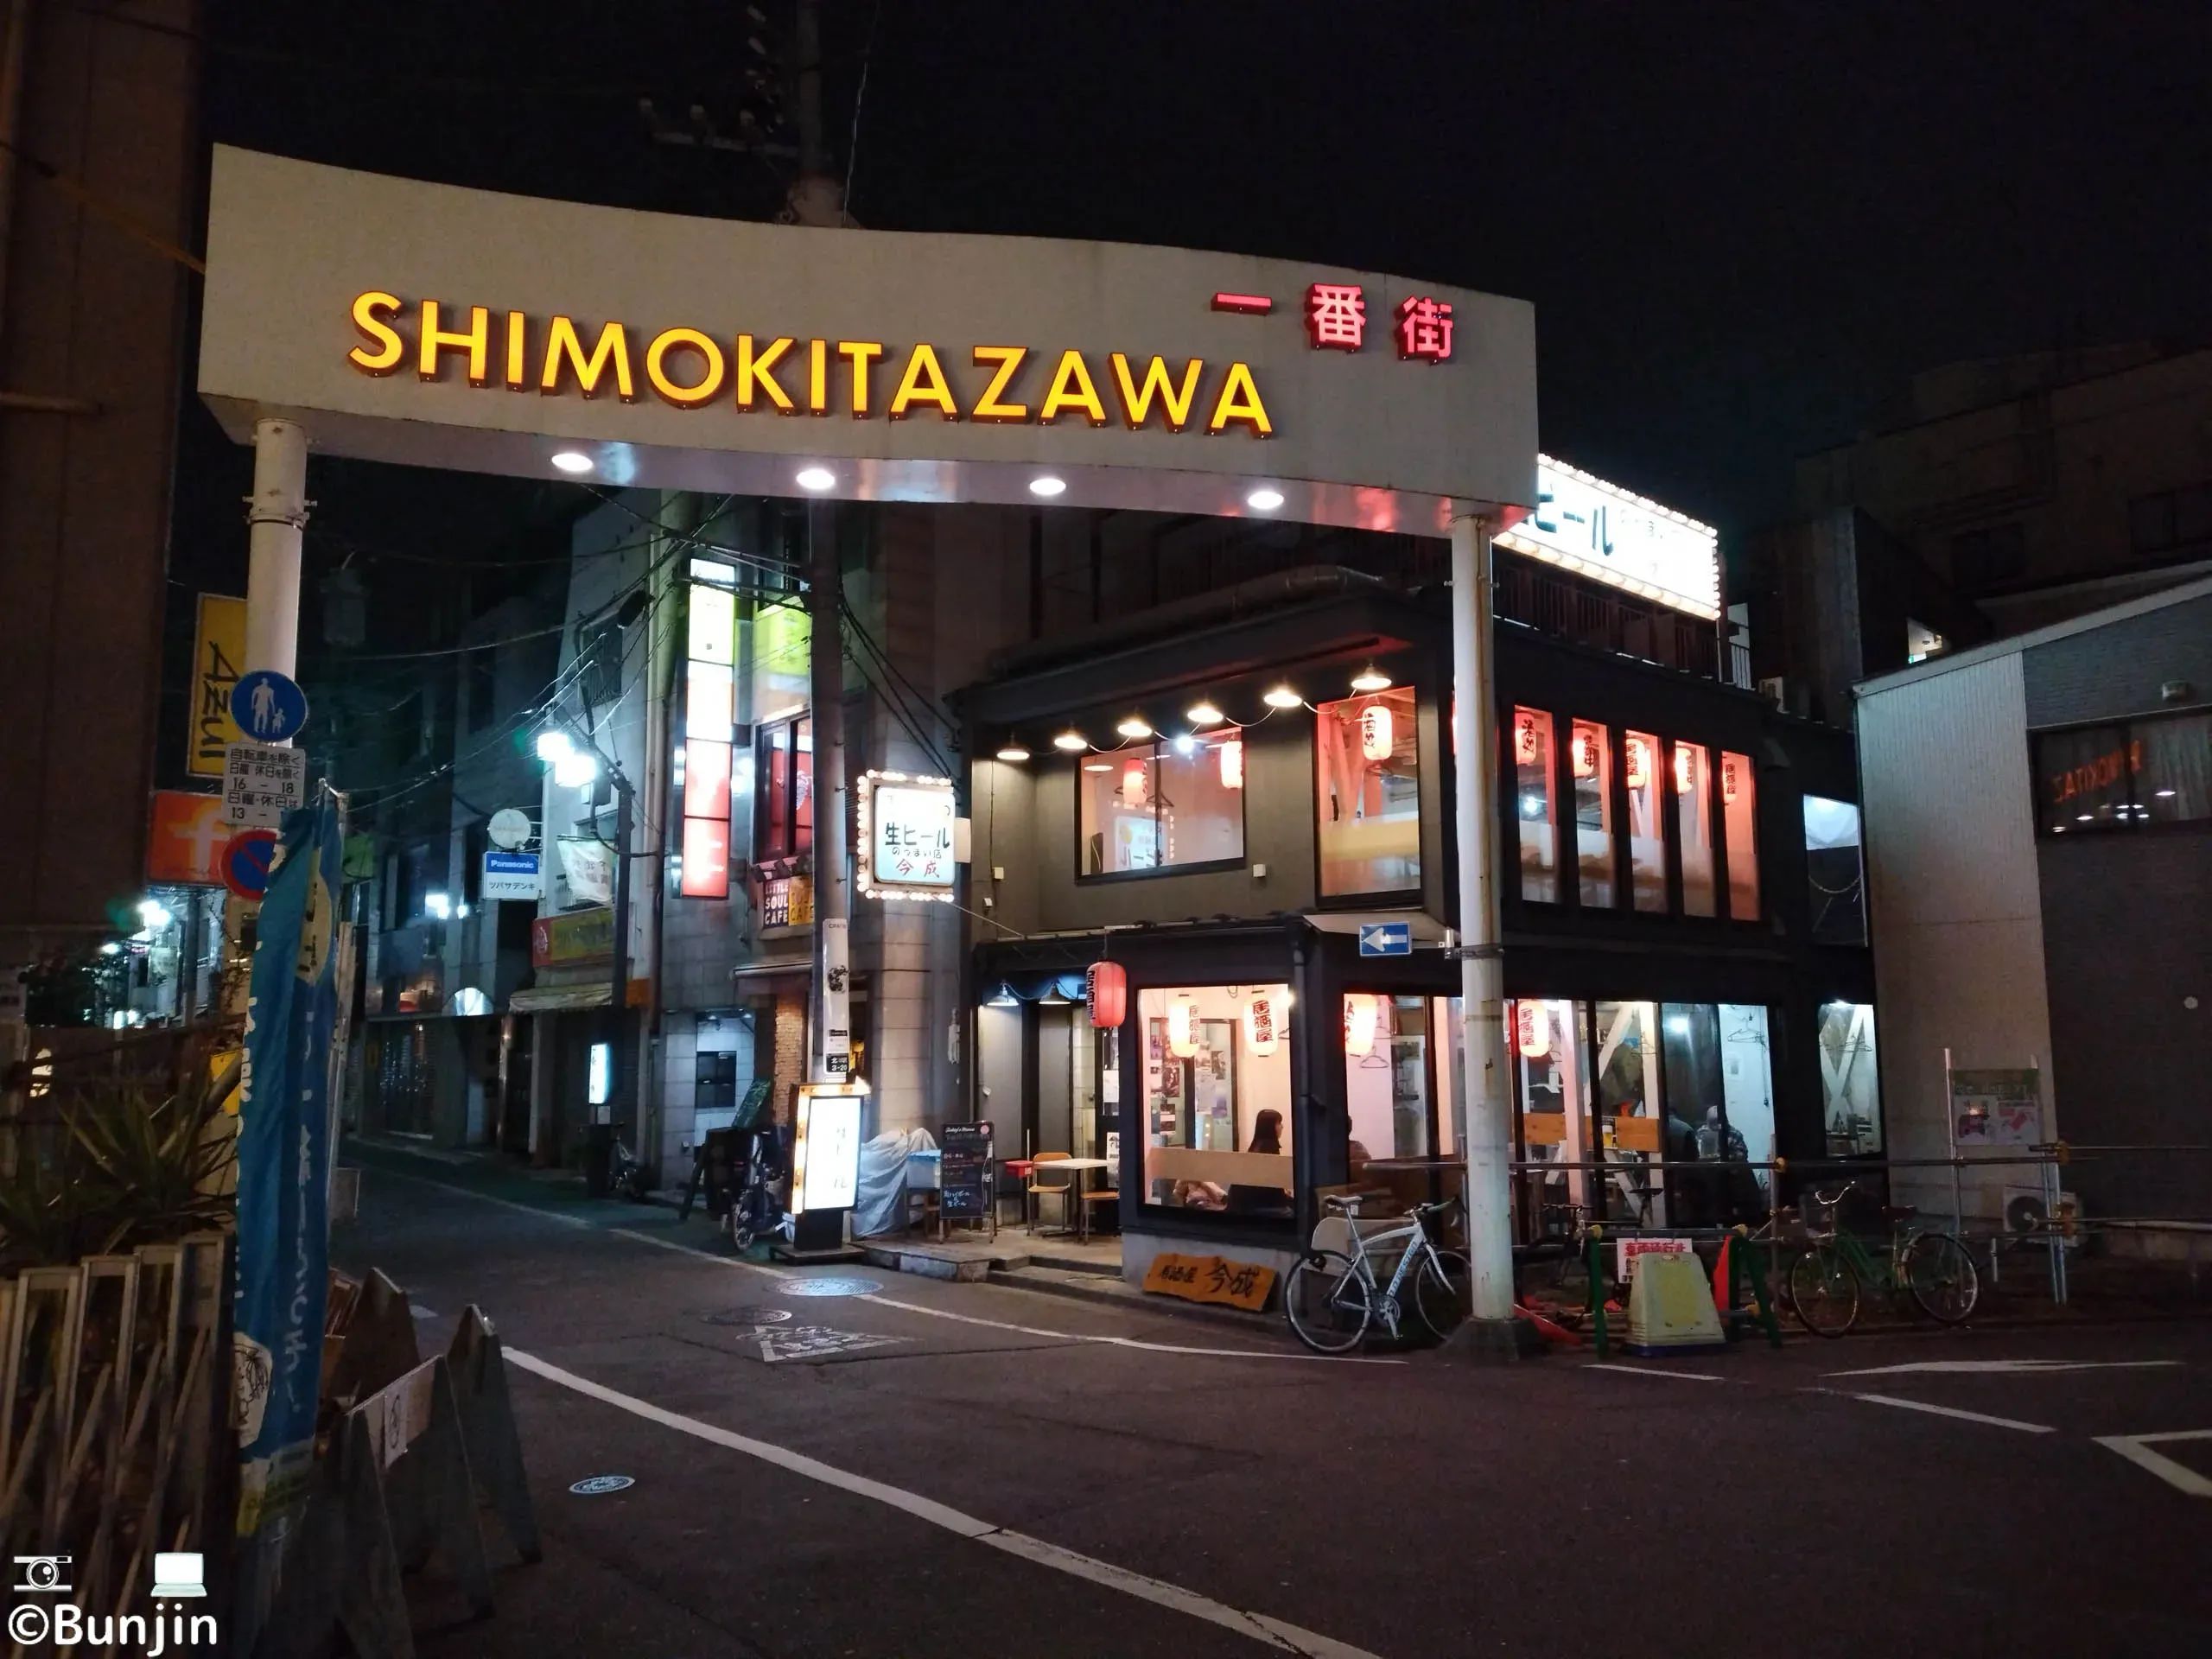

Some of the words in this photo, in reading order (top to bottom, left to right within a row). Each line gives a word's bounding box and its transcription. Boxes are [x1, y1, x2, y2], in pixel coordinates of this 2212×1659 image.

[1213, 283, 1453, 359] 一番街
[348, 291, 1271, 435] SHIMOKITAZAWA
[491, 859, 535, 869] Panasonic
[765, 894, 788, 910] SOUL
[765, 909, 788, 925] CAFE
[1253, 1000, 1273, 1042] 居酒屋
